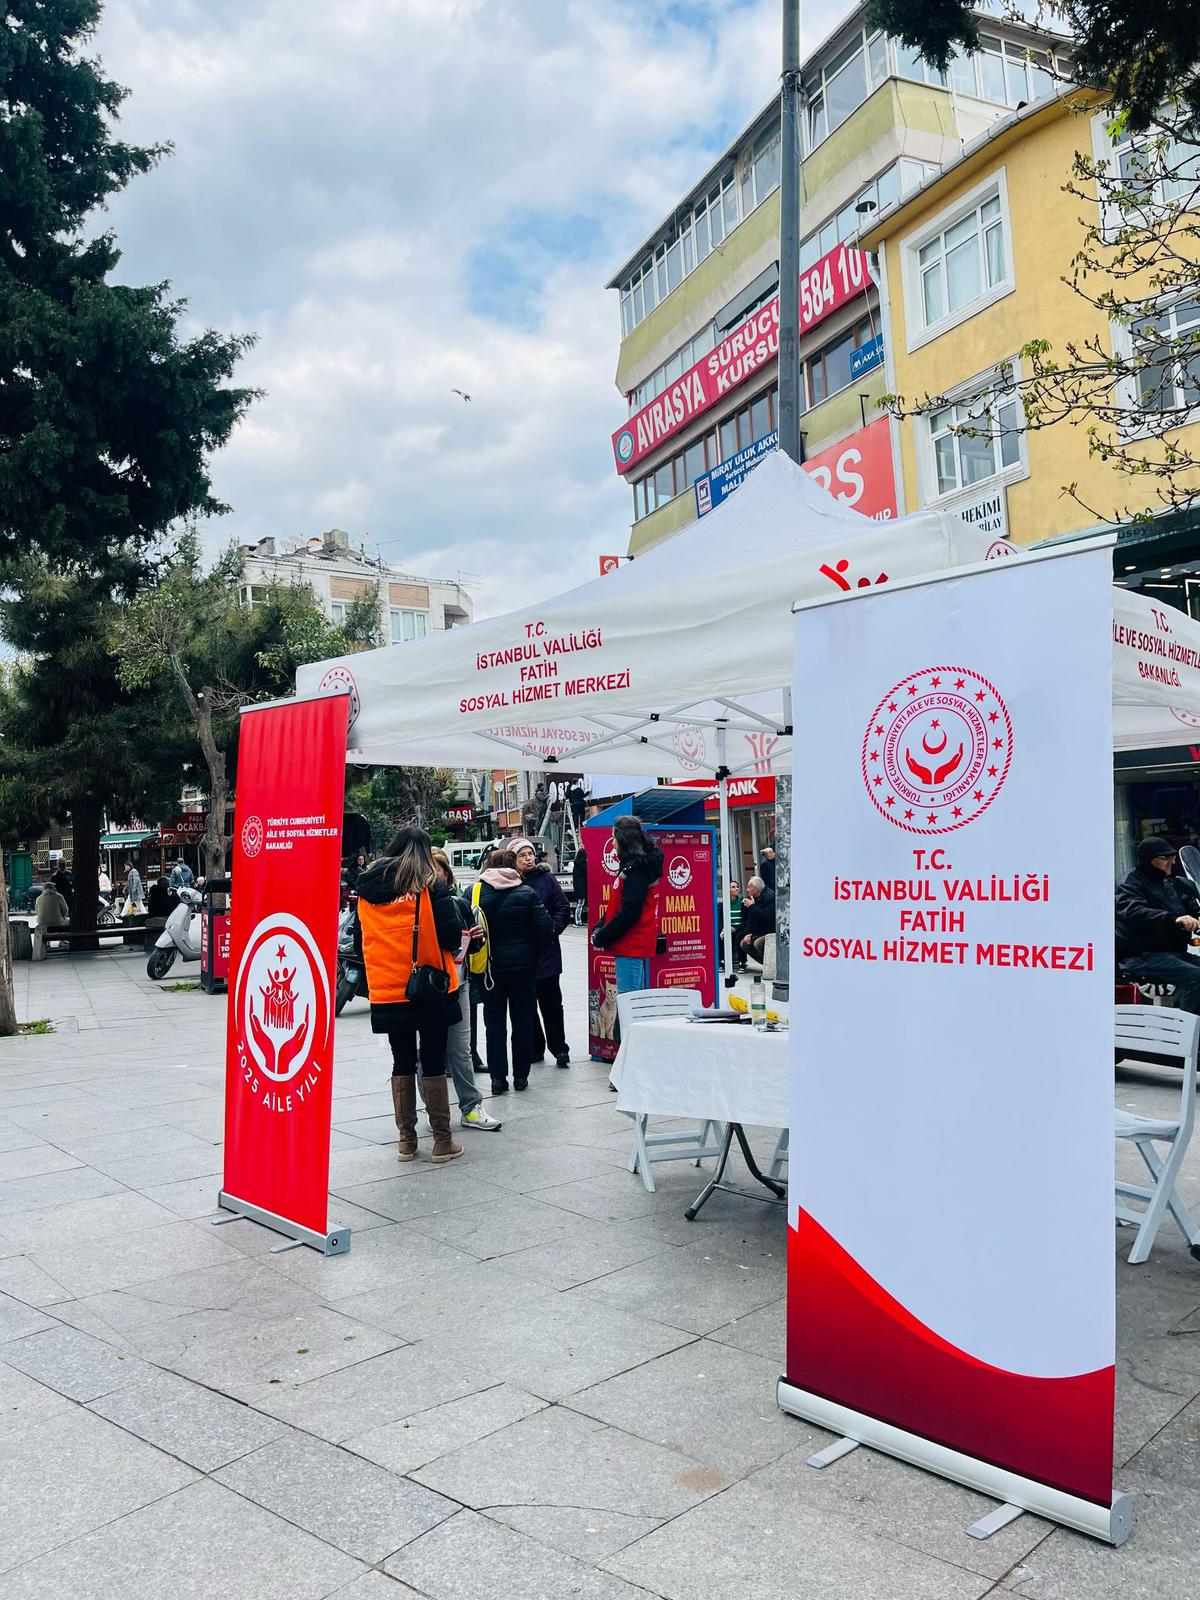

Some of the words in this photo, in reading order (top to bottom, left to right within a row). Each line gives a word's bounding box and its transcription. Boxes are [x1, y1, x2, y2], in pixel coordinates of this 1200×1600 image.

[801, 259, 834, 323] 584
[838, 247, 862, 294] 10
[637, 370, 706, 453] AVRASYA
[735, 445, 756, 466] ULUK
[961, 495, 1000, 523] HEKİMİ
[525, 621, 548, 639] T.C.
[1151, 608, 1173, 634] T.C.
[477, 645, 541, 670] İSTANBUL
[544, 629, 602, 655] VALİLİĞİ
[1126, 627, 1136, 648] VE
[1138, 632, 1167, 657] SOSYAL
[520, 660, 559, 682] FATİH
[1138, 661, 1182, 687] BAKANLIĞI
[459, 693, 509, 713] SOSYAL
[512, 682, 561, 705] HİZMET
[565, 671, 630, 696] MERKEZİ
[924, 697, 937, 706] VE
[937, 696, 967, 712] SOSYAL
[906, 702, 924, 717] AİLE
[887, 714, 907, 777] CUMHURİYETİ
[965, 709, 984, 760] HİZMETLER
[893, 776, 921, 802] TÜRKİYE
[943, 761, 982, 802] BAKANLIĞI
[266, 829, 278, 838] AİLE
[279, 829, 286, 838] VE
[286, 829, 305, 838] SOSYAL
[913, 849, 953, 871] T.C.
[834, 875, 937, 902] İSTANBUL
[943, 873, 1050, 903] VALİLİĞİ
[665, 895, 696, 913] MAMA
[661, 915, 701, 935] OTOMATI
[900, 905, 965, 933] FATİH
[803, 937, 878, 961] SOSYAL
[883, 932, 969, 965] HİZMET
[976, 942, 1094, 972] MERKEZİ
[237, 1041, 259, 1093] 2025
[263, 1092, 293, 1113] AİLE
[296, 1060, 322, 1102] YILI
